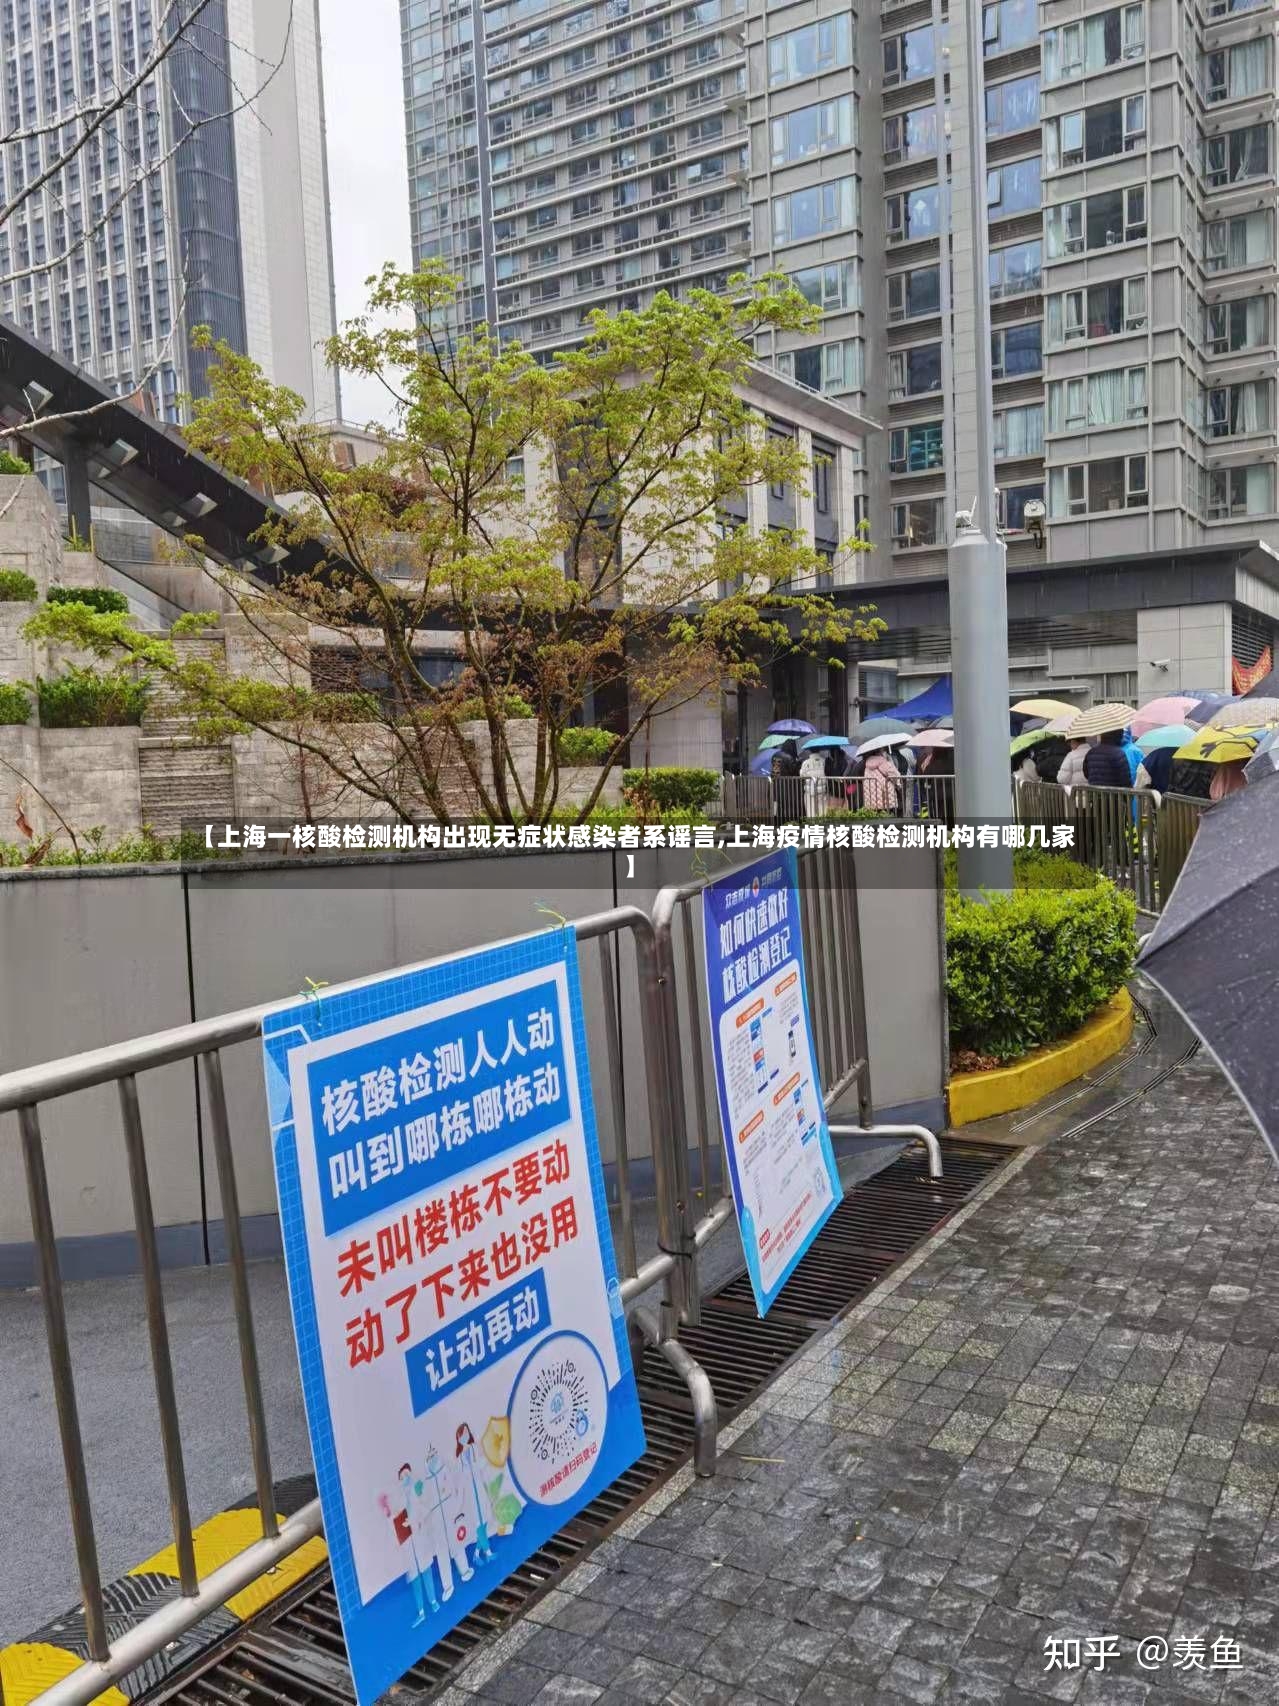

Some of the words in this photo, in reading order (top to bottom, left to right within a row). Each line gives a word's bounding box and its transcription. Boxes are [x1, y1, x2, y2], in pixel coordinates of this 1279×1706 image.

[719, 886, 789, 959] 如何快速做好
[722, 925, 792, 1004] 核酸检测登记
[321, 1006, 555, 1136] 核酸检测人人动
[328, 1062, 561, 1199] 叫到哪栋哪栋动
[337, 1138, 571, 1298] 未叫楼栋不要动
[345, 1195, 579, 1369] 动了下来也没用
[424, 1286, 540, 1391] 让动再动
